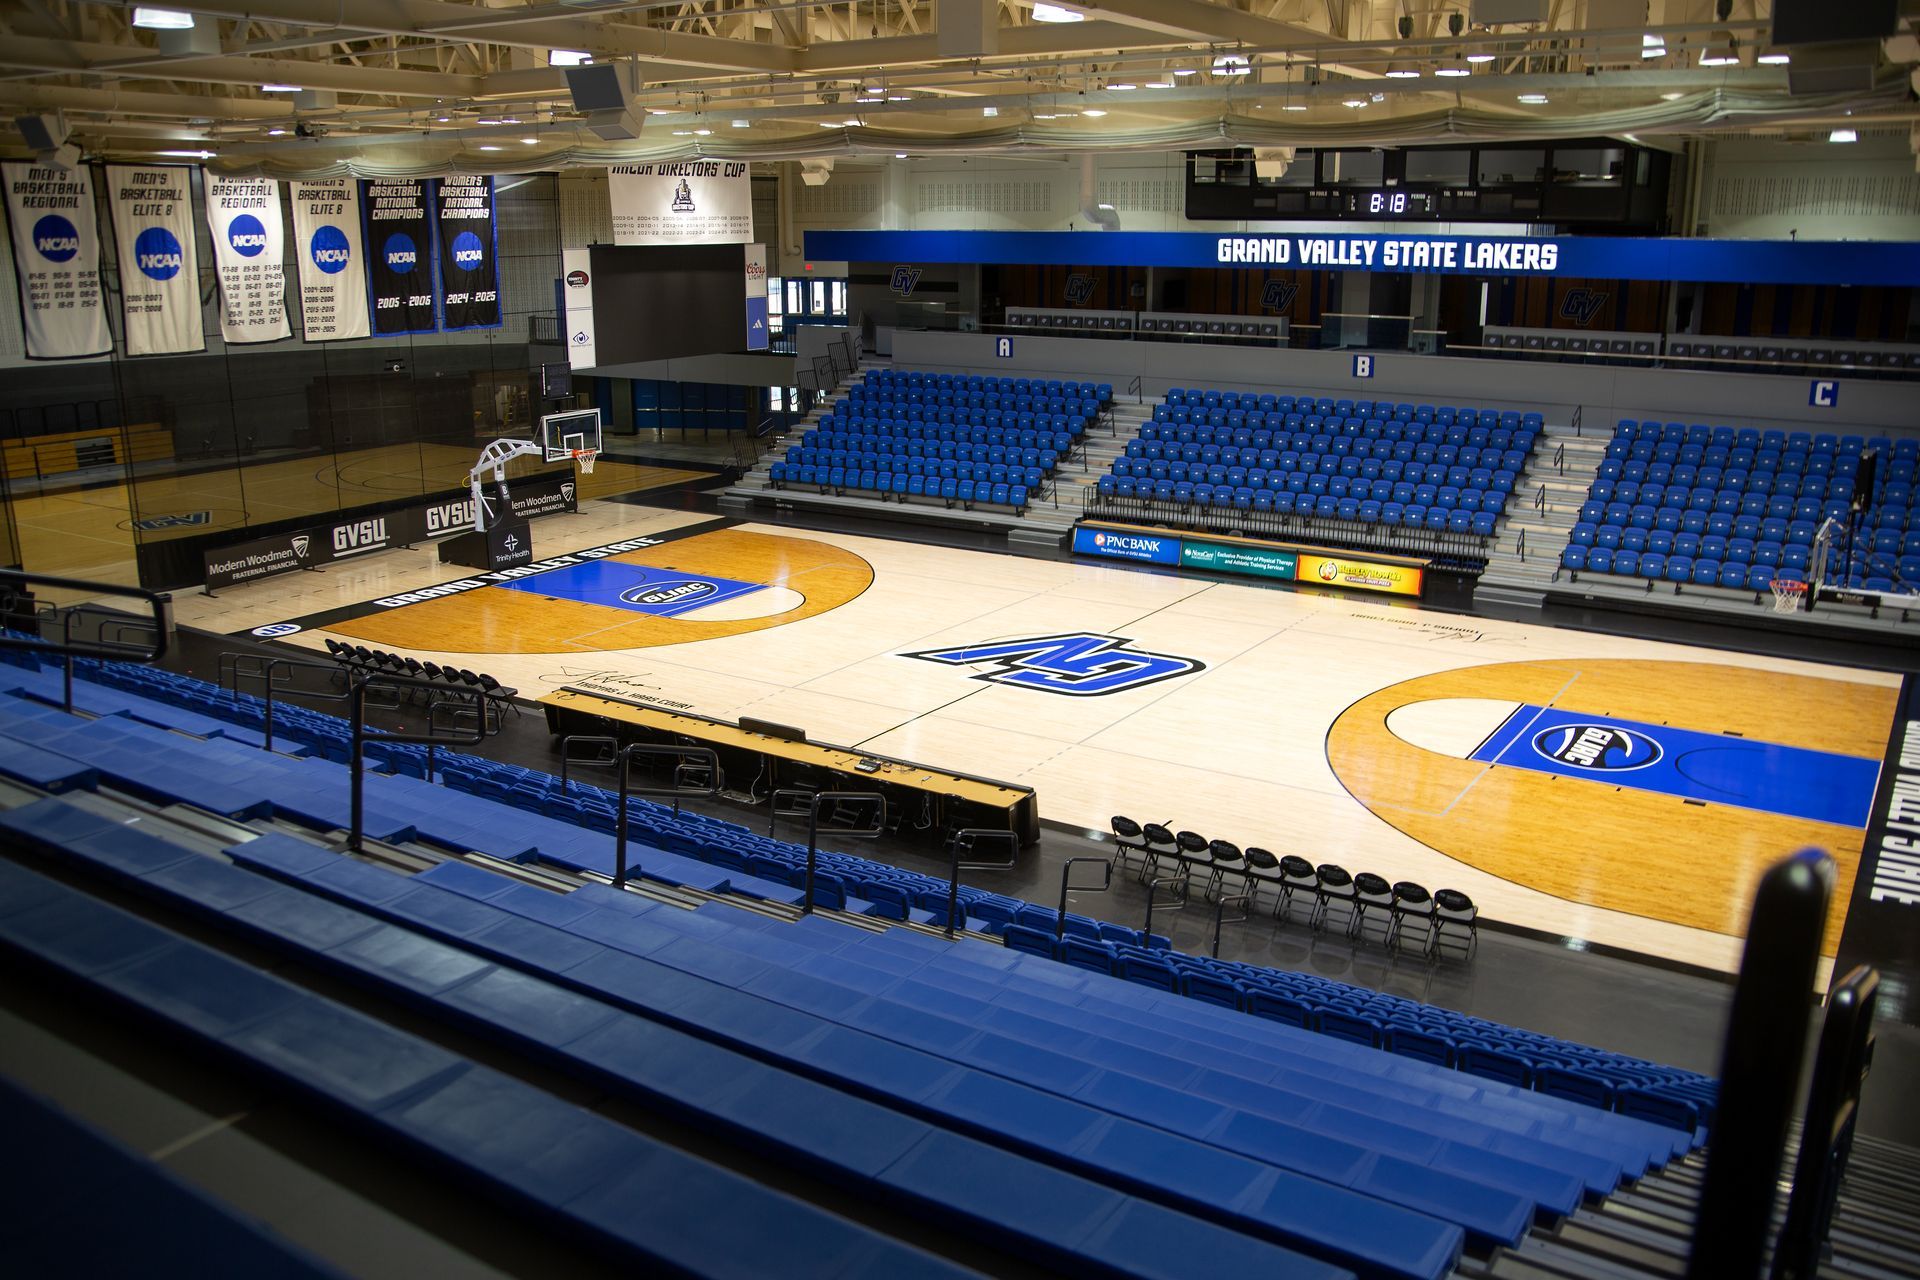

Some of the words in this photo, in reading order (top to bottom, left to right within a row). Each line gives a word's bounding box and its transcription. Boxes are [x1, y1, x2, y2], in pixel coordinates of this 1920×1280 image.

[28, 168, 68, 181] MENS
[658, 162, 721, 177] DIRECTORS'
[724, 163, 746, 178] CUP
[132, 172, 168, 185] MEN'S
[218, 176, 265, 184] WOMENS
[13, 182, 86, 195] BASKETBALL
[120, 188, 183, 200] BASKETBALL
[211, 185, 272, 196] BASKETBALL
[298, 189, 352, 201] BASKETBALL
[369, 186, 422, 197] BASKETBALL
[439, 186, 488, 197] BASKETBALL
[22, 196, 80, 209] REGIONAL
[220, 198, 267, 208] REGIONAL
[376, 197, 417, 208] NATIONAL
[445, 197, 483, 208] NATIONAL
[1370, 193, 1405, 213] 8:18
[132, 204, 162, 216] ELITE
[166, 204, 173, 216] 8
[310, 204, 335, 215] ELITE
[336, 204, 343, 215] 8
[372, 208, 424, 220] CHAMPIONS
[441, 208, 490, 219] CHAMPIONS
[39, 237, 79, 251] NCAA
[232, 235, 266, 247] NCAA
[315, 250, 349, 263] NCAA
[388, 252, 416, 264] NCAA
[456, 250, 483, 262] NCAA
[1217, 238, 1290, 263] GRAND
[1298, 239, 1377, 266] VALLEY
[1383, 240, 1457, 268] STATE
[1464, 242, 1558, 271] LAKERS
[140, 254, 182, 269] NCAA
[377, 297, 400, 309] 2005
[409, 295, 432, 307] 2006
[446, 292, 469, 304] 2024
[475, 291, 496, 302] 2025
[999, 338, 1010, 356] A
[1357, 356, 1370, 377] B
[1815, 382, 1833, 405] C
[526, 493, 562, 507] Woodmen
[541, 502, 566, 513] FINANCIAL
[333, 517, 386, 551] GVSU
[1106, 535, 1130, 548] PNC
[1130, 538, 1161, 552] BANK
[209, 558, 246, 576] Modern
[246, 548, 293, 567] Woodmen
[495, 553, 513, 563] Trinity
[512, 549, 530, 560] Health
[232, 565, 267, 580] FRATERNAL
[267, 559, 299, 573] FINANCIAL
[373, 579, 487, 608] GRAND
[479, 555, 583, 582] VALLEY
[577, 536, 665, 561] STATE
[642, 582, 706, 603] GLIAC
[1564, 727, 1614, 766] GLIAC
